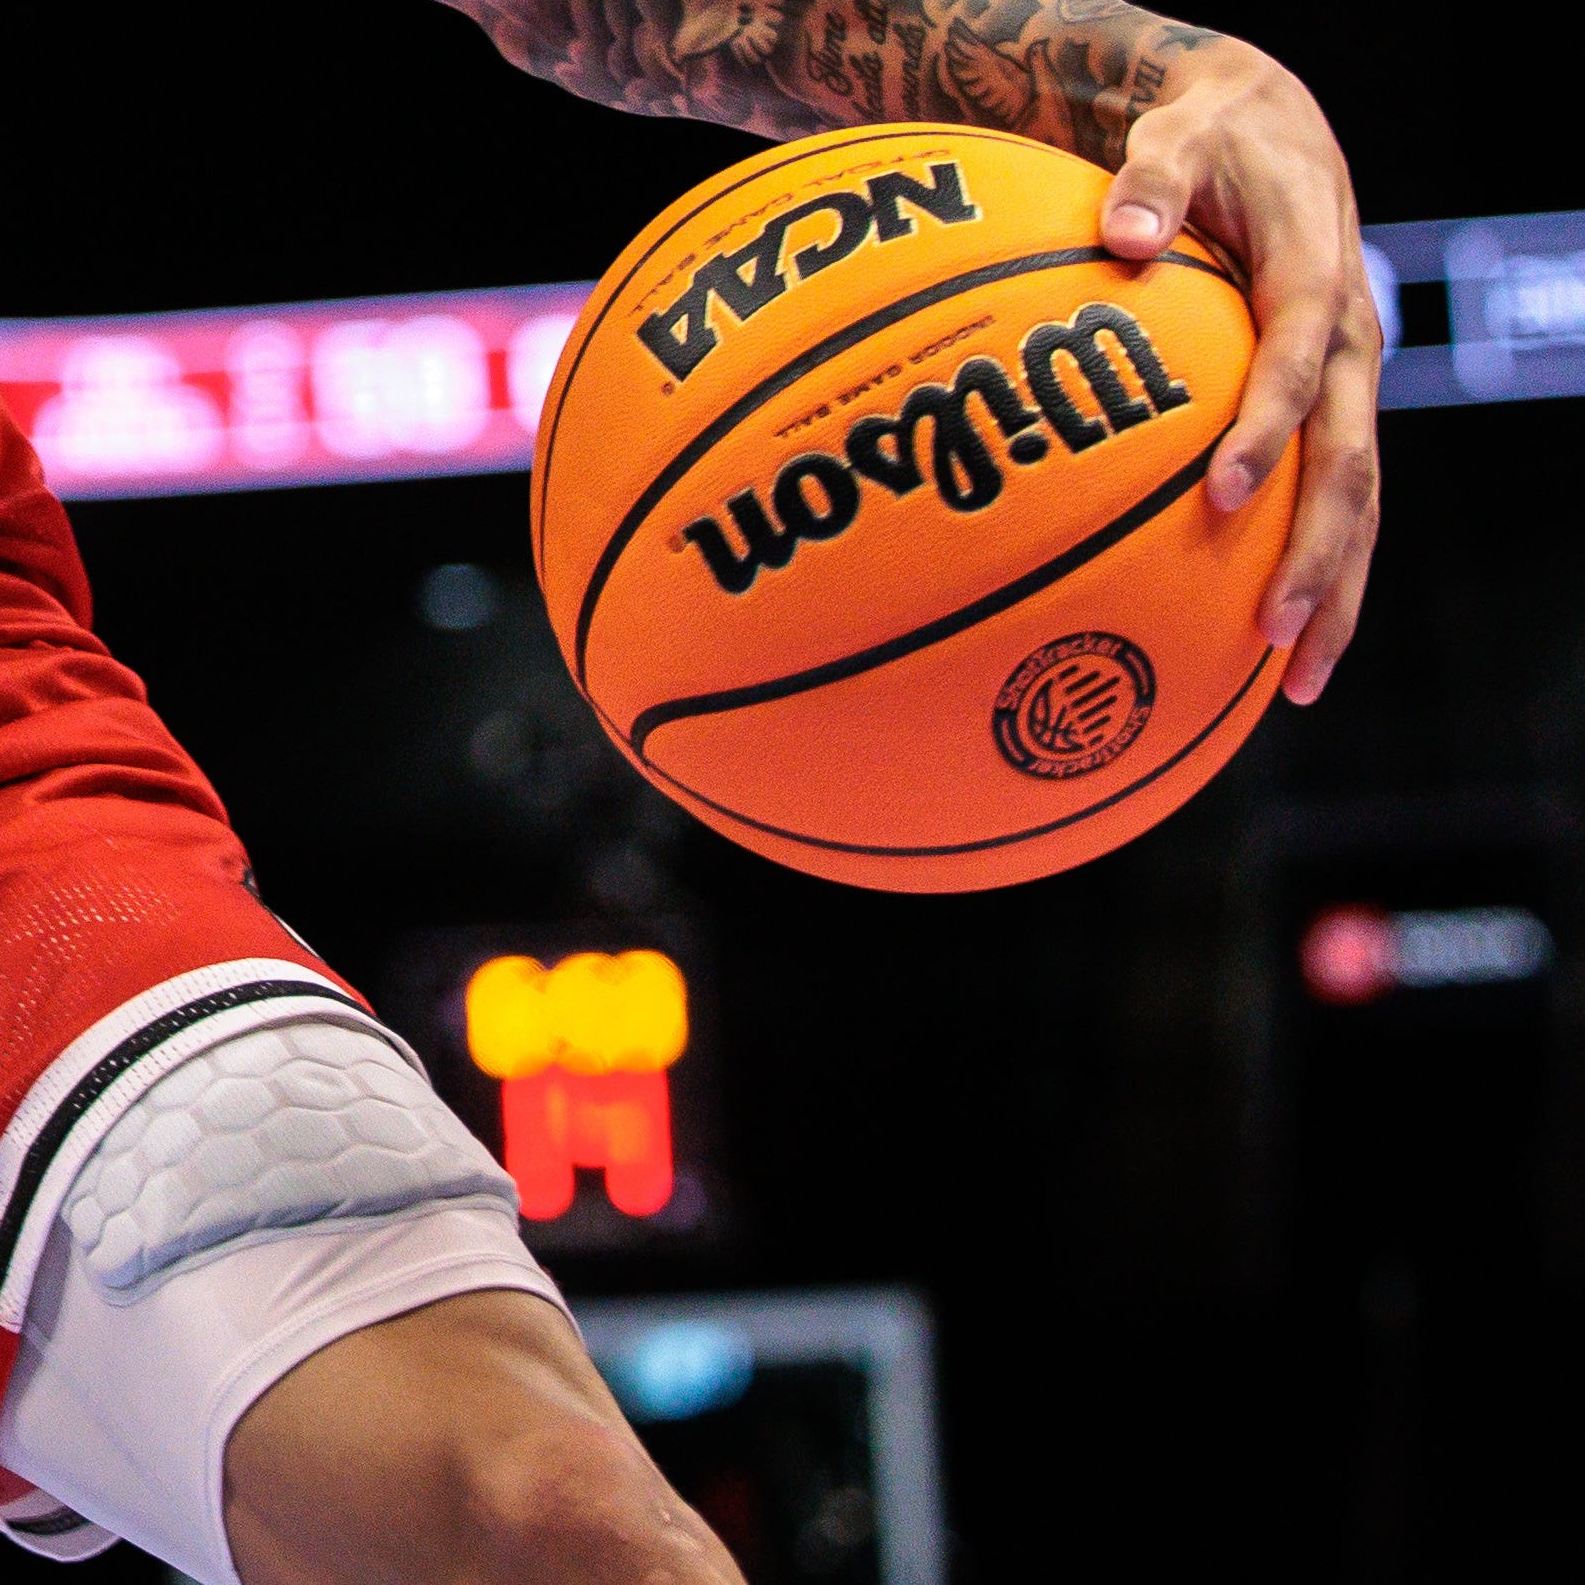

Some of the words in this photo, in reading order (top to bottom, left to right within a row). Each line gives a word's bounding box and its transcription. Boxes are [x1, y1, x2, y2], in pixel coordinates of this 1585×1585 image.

[635, 158, 983, 384] NCAA
[682, 300, 1194, 597] Wilson
[772, 402, 832, 438] BALL
[836, 363, 903, 406] GAME
